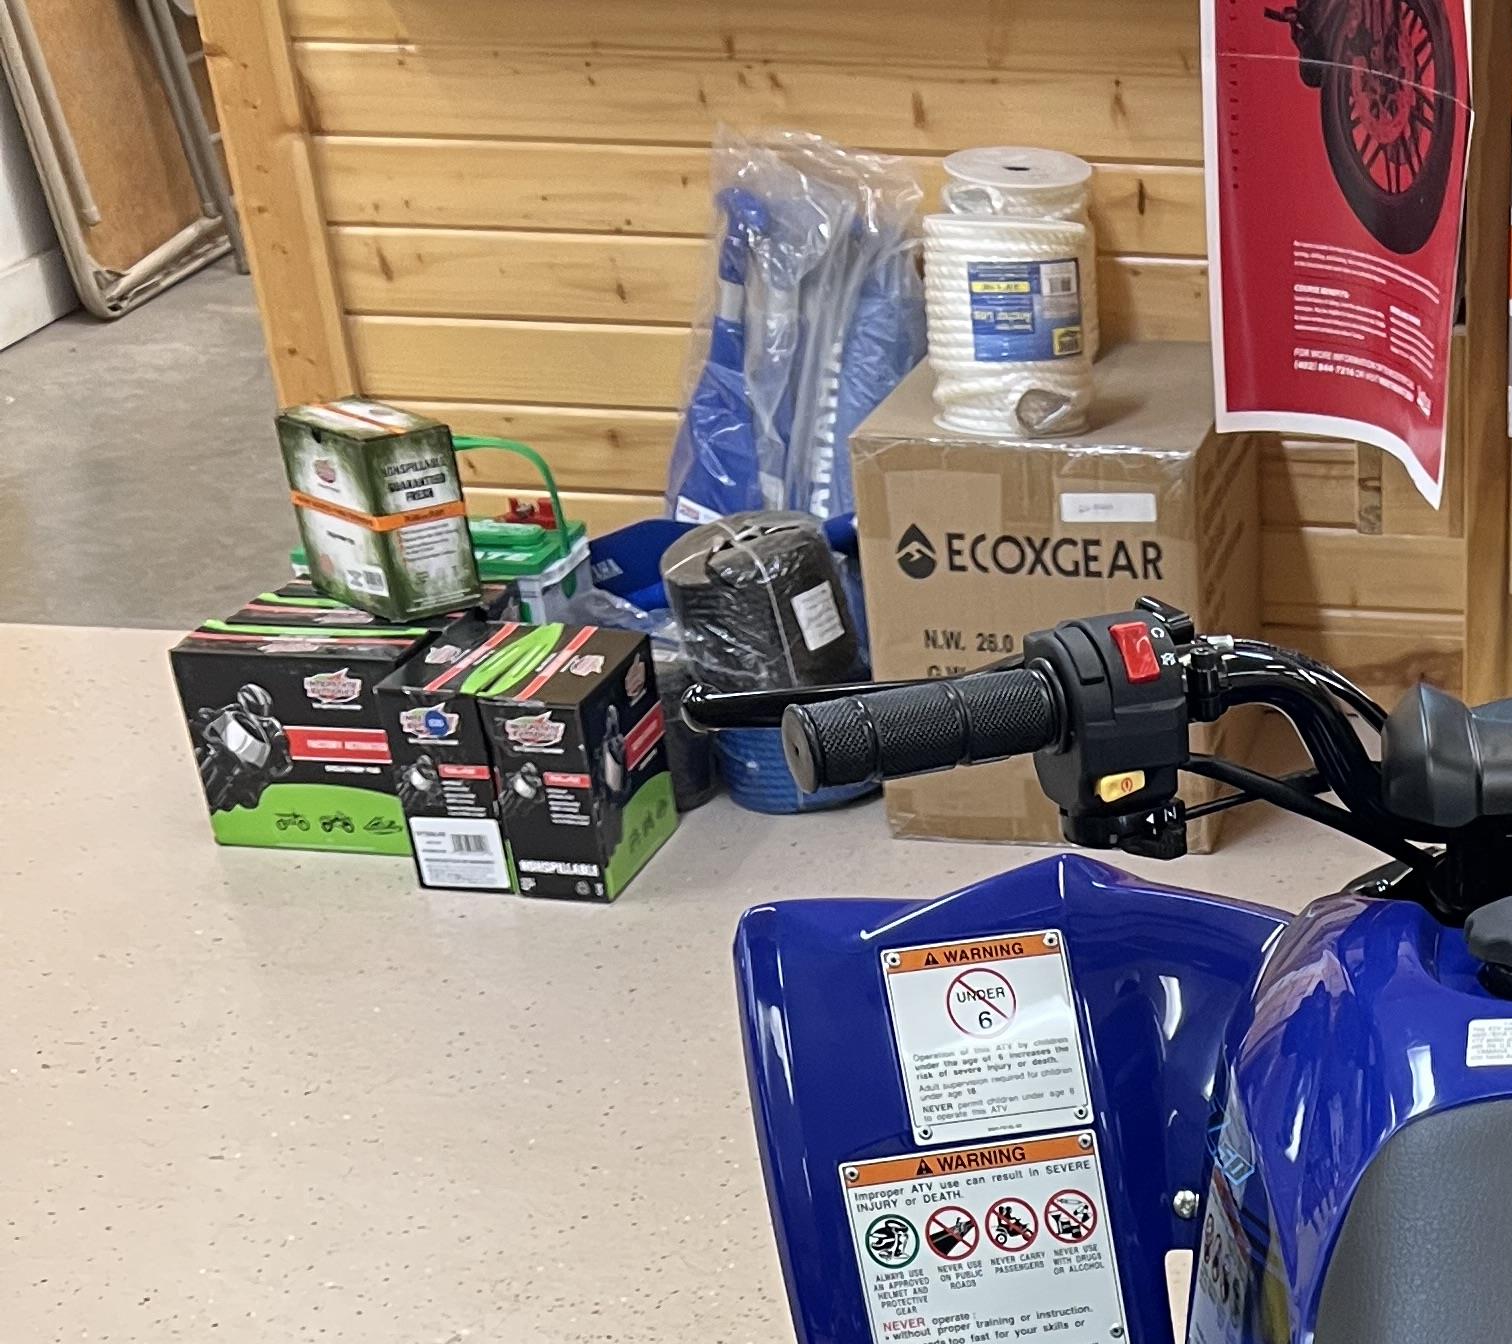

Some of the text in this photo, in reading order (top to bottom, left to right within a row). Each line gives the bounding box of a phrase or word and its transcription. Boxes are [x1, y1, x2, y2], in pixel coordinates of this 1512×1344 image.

[945, 532, 1164, 581] ECOXGEAR
[924, 629, 966, 651] N.W.
[943, 942, 1024, 963] WARNING
[956, 987, 1005, 1003] UNDER
[977, 1010, 993, 1029] 6
[922, 1103, 953, 1113] NEVER
[937, 1146, 1026, 1172] WARNING
[853, 1186, 905, 1204] Improper
[910, 1182, 933, 1193] ATV
[939, 1180, 959, 1189] use
[966, 1176, 985, 1185] can
[991, 1170, 1022, 1182] result
[1045, 1160, 1091, 1174] SEVERE
[856, 1198, 898, 1212] INJURY
[904, 1197, 917, 1206] or
[882, 1317, 926, 1332] NEVER
[892, 1328, 931, 1340] without
[937, 1322, 971, 1336] proper
[975, 1315, 1015, 1330] training
[1020, 1314, 1031, 1322] or
[948, 1336, 965, 1344] too
[970, 1332, 989, 1342] fast
[994, 1329, 1009, 1339] for
[1014, 1326, 1037, 1338] your
[1042, 1320, 1069, 1332] skills
[1074, 1319, 1085, 1327] or
